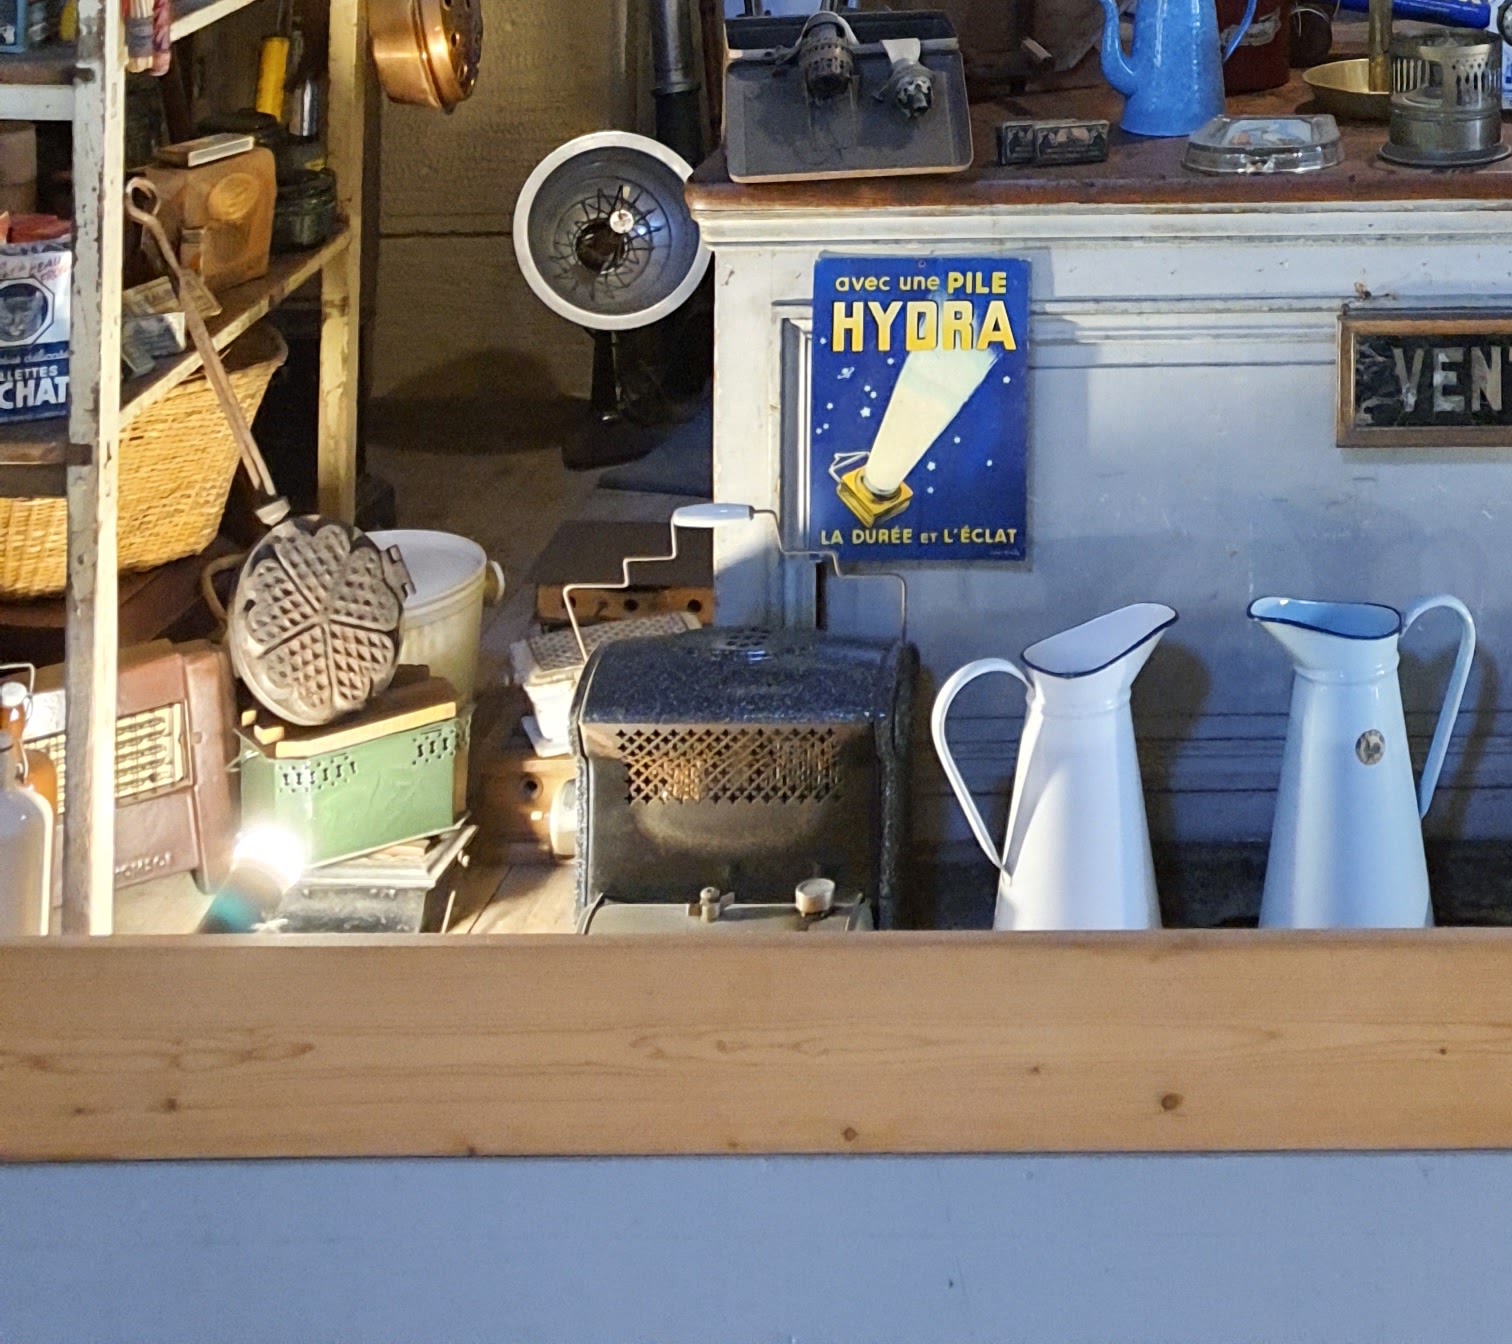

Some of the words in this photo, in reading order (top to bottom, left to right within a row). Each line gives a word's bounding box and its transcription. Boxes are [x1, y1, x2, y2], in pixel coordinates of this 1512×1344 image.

[834, 275, 891, 292] avec
[899, 275, 941, 292] une
[947, 271, 1007, 294] PILE
[831, 299, 1017, 353] HYDRA
[820, 529, 844, 546] LA
[852, 525, 914, 546] DURÉE
[920, 531, 939, 545] ET
[943, 524, 1018, 545] L'ÉCLAT
